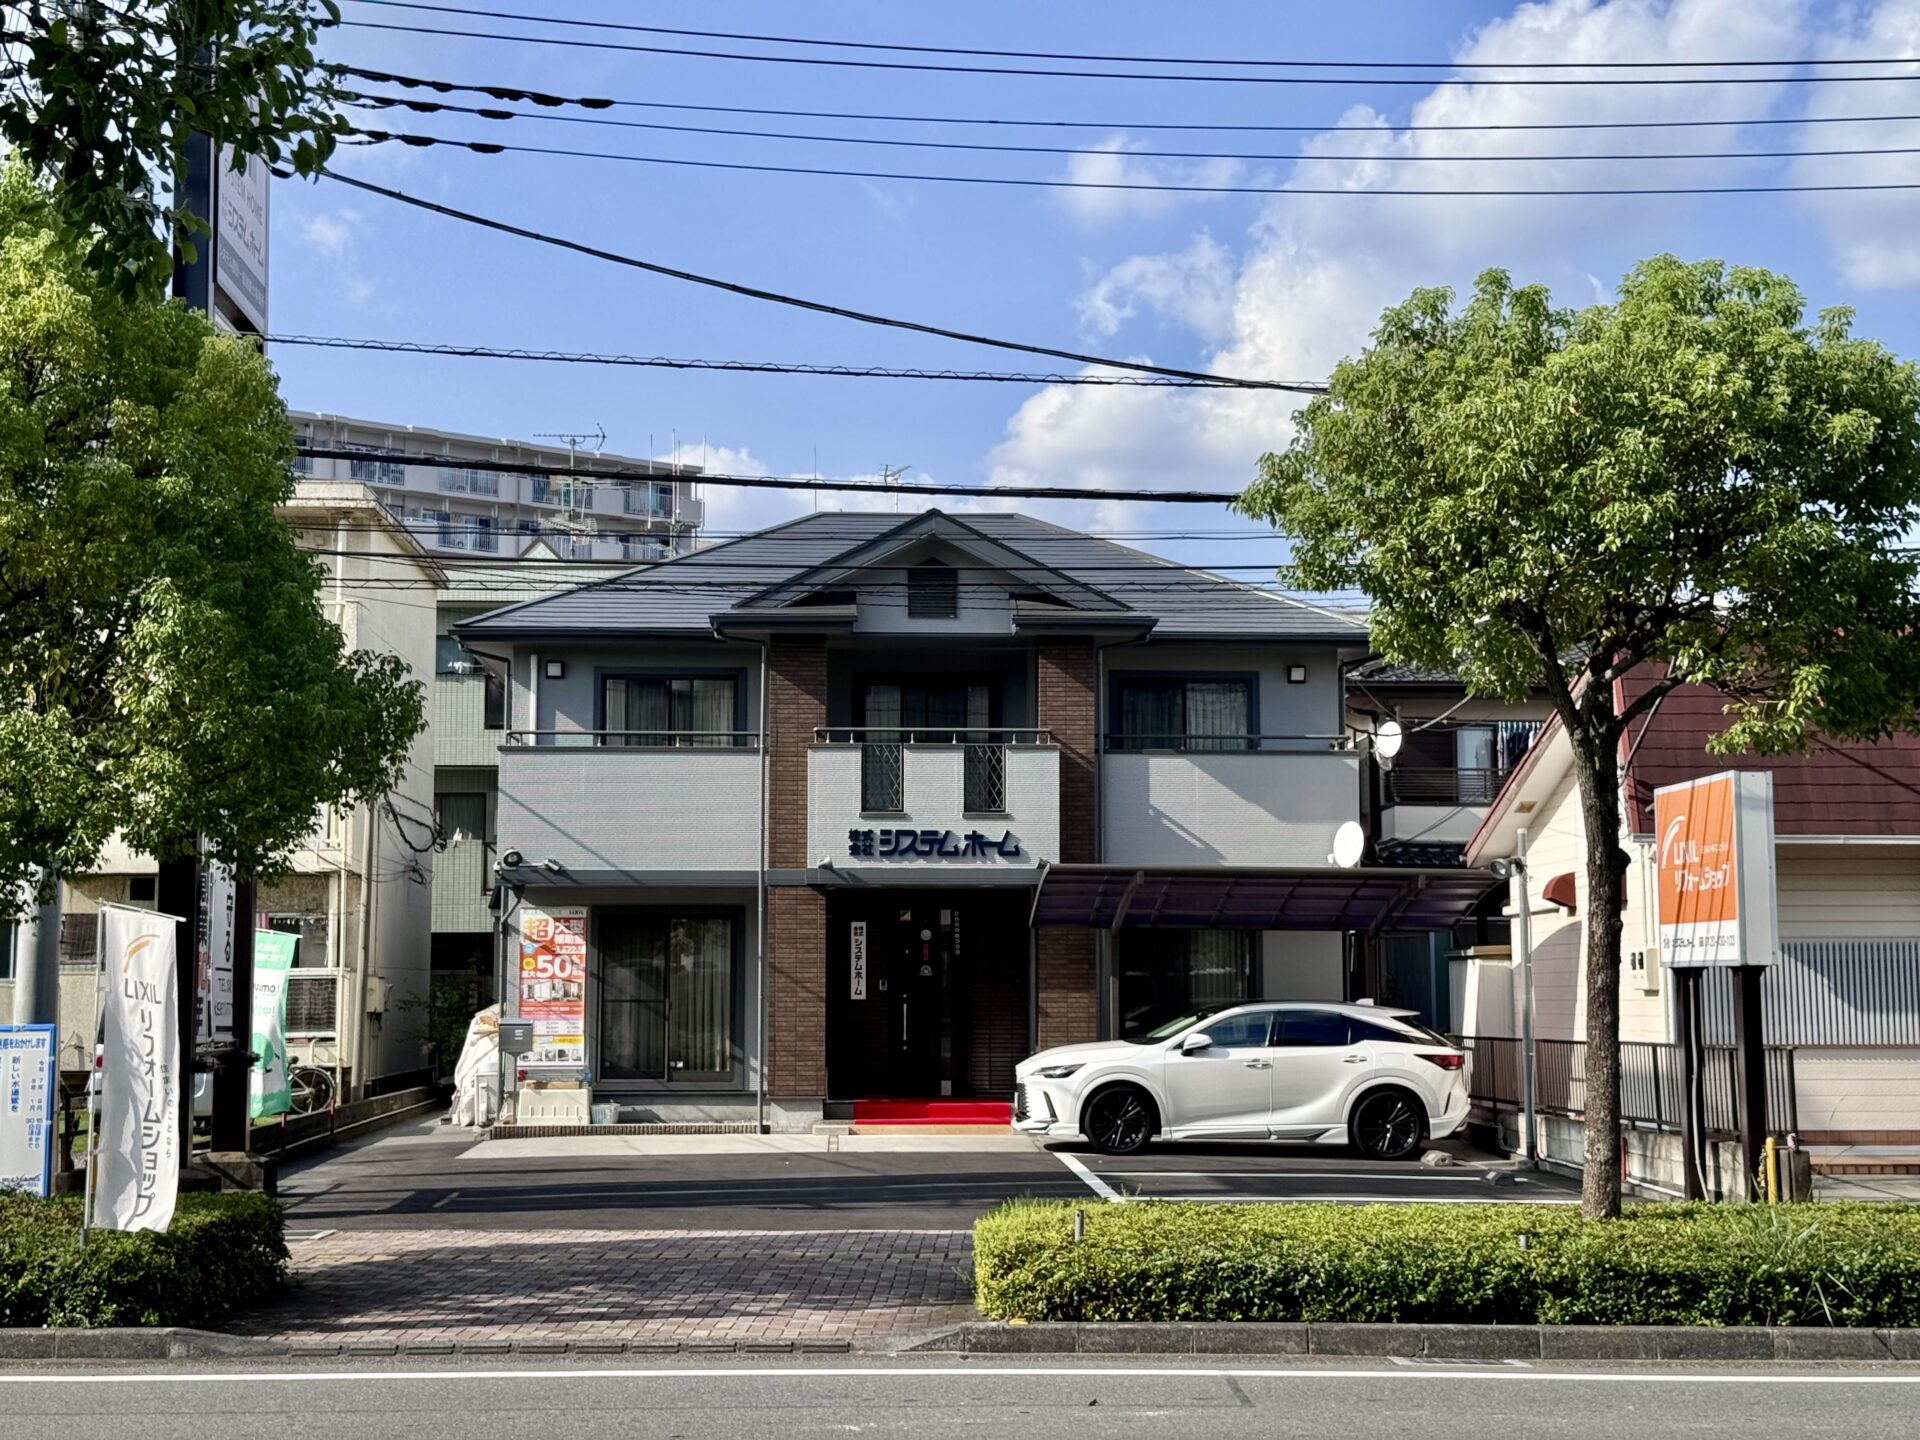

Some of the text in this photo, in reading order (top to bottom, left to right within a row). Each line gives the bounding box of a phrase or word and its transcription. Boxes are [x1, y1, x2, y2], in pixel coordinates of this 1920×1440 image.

[879, 829, 1021, 857] システムホーム
[1673, 840, 1700, 865] LIXIL
[536, 954, 572, 978] 50
[854, 938, 863, 996] システムホーム
[124, 977, 163, 1005] LIXIL
[133, 1008, 163, 1218] リフォームショップ
[160, 1063, 174, 1159] 住まいのことなら
